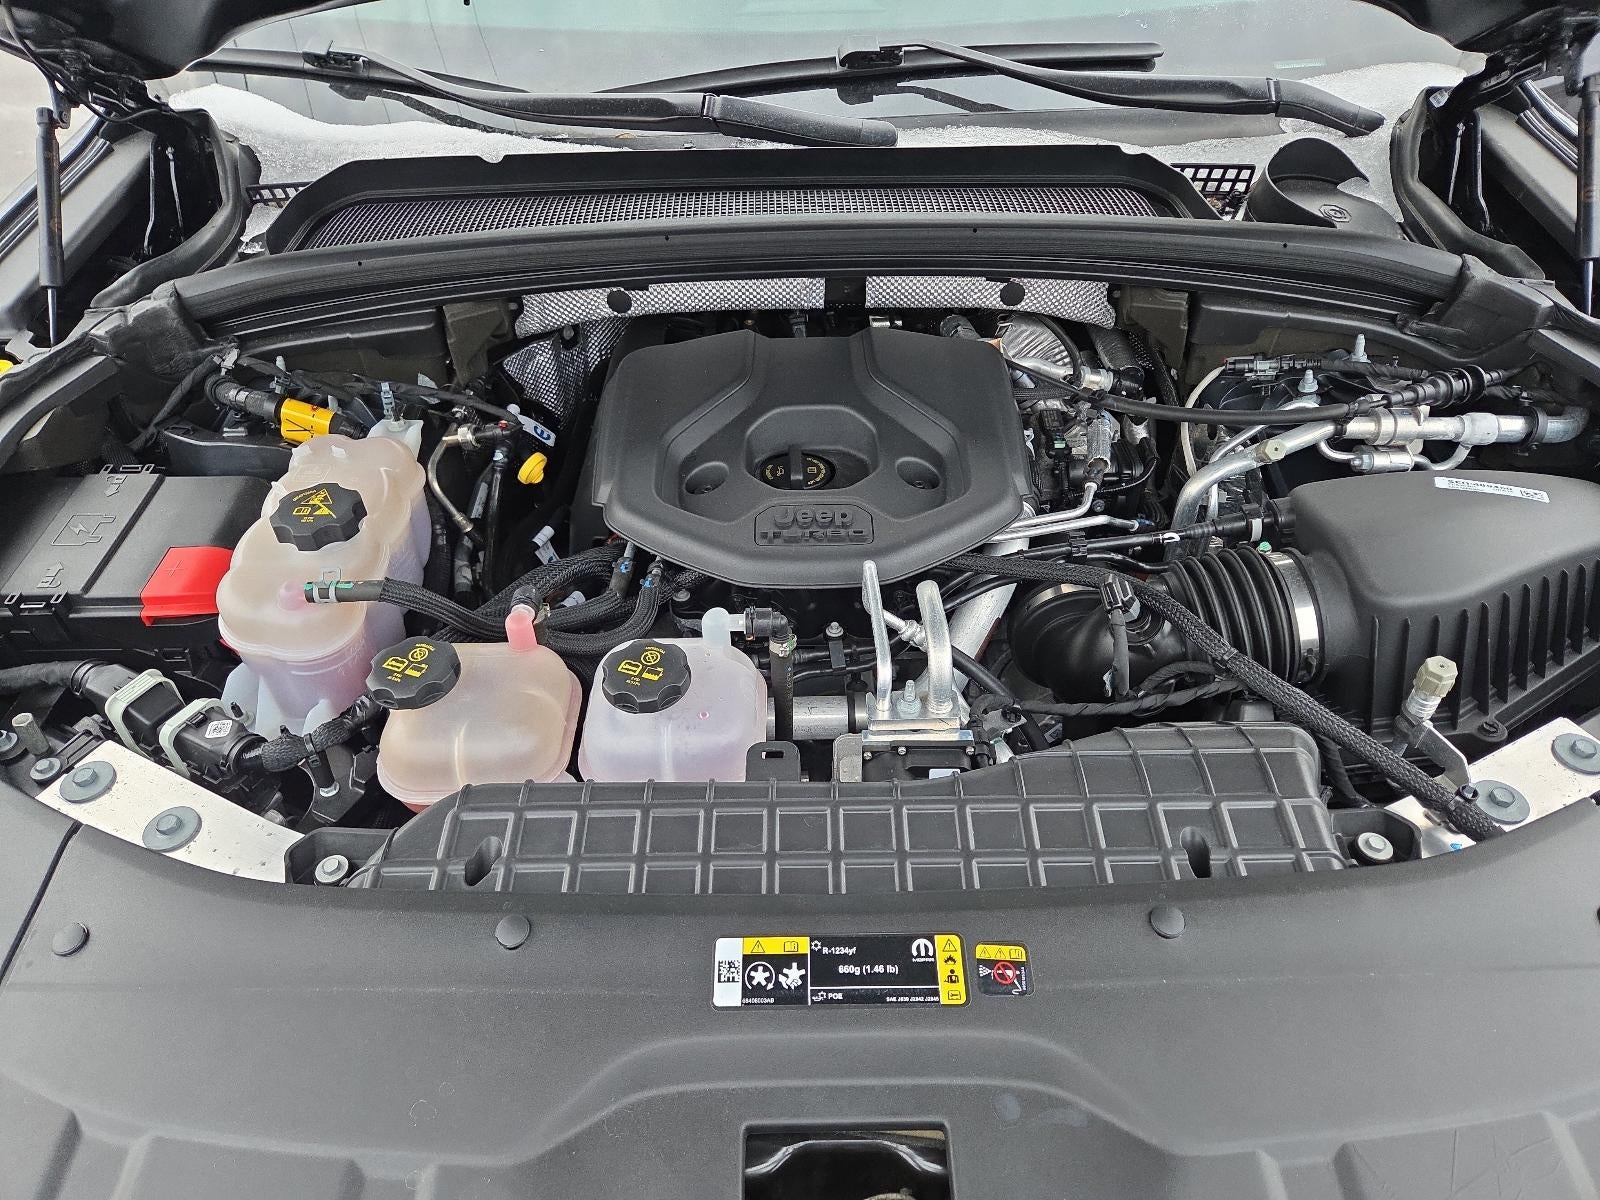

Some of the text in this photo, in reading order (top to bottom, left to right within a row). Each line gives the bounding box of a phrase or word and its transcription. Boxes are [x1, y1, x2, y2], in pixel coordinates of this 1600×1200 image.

[773, 508, 854, 529] Jeep
[822, 946, 857, 956] R-1234yf
[838, 964, 899, 976] 660g (1.46 lb)
[828, 992, 843, 1000] POE
